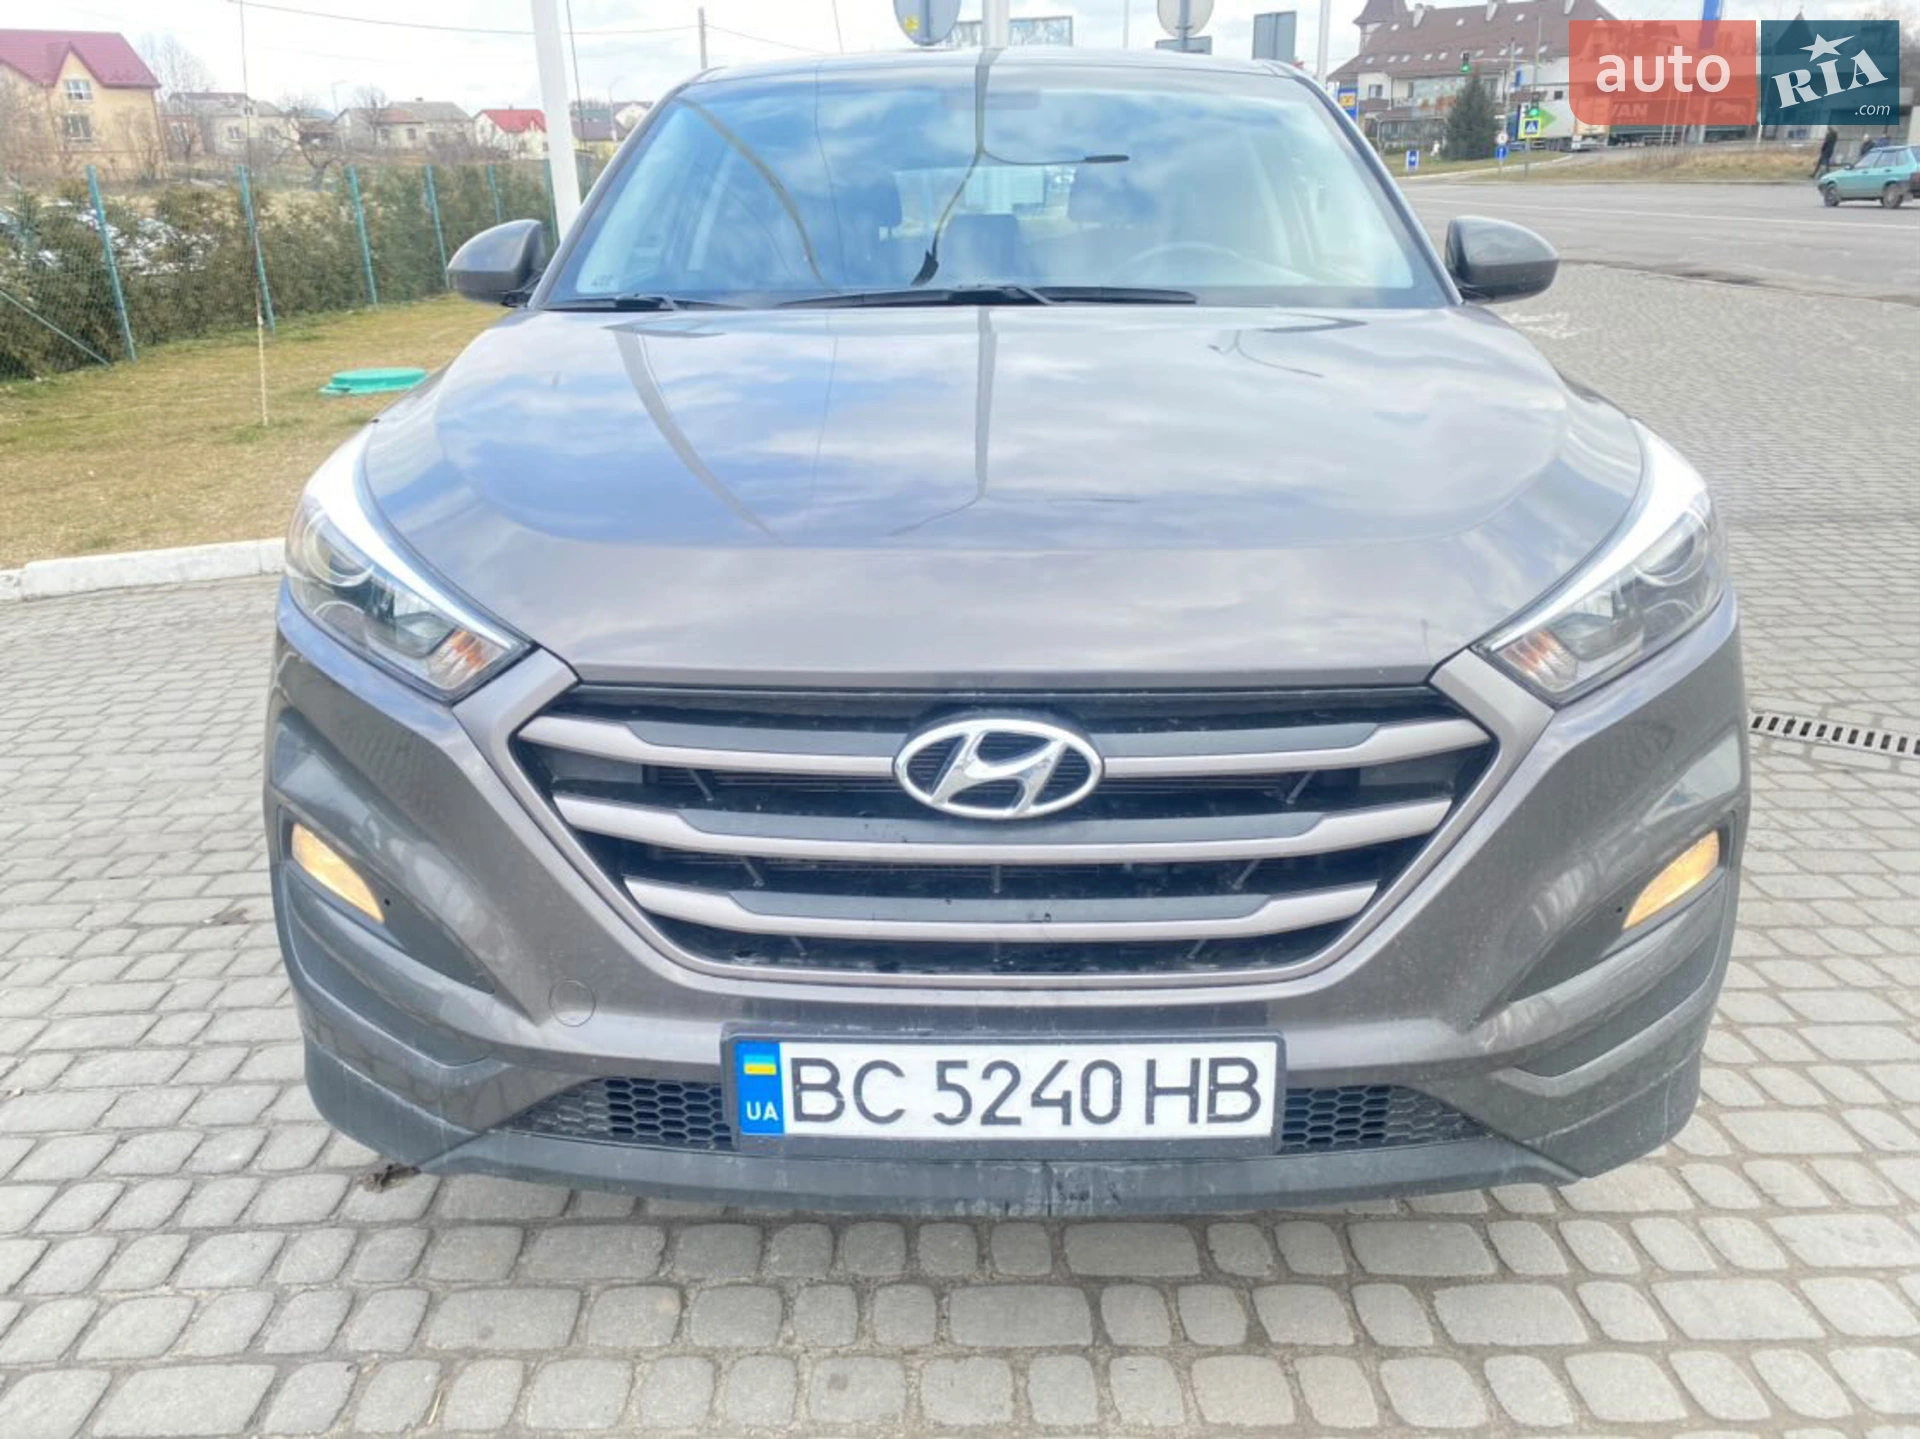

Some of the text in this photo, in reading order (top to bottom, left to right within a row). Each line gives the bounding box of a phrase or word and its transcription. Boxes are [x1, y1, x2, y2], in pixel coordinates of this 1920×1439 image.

[745, 1102, 779, 1122] UA
[789, 1056, 1262, 1126] BC 5240 HB
